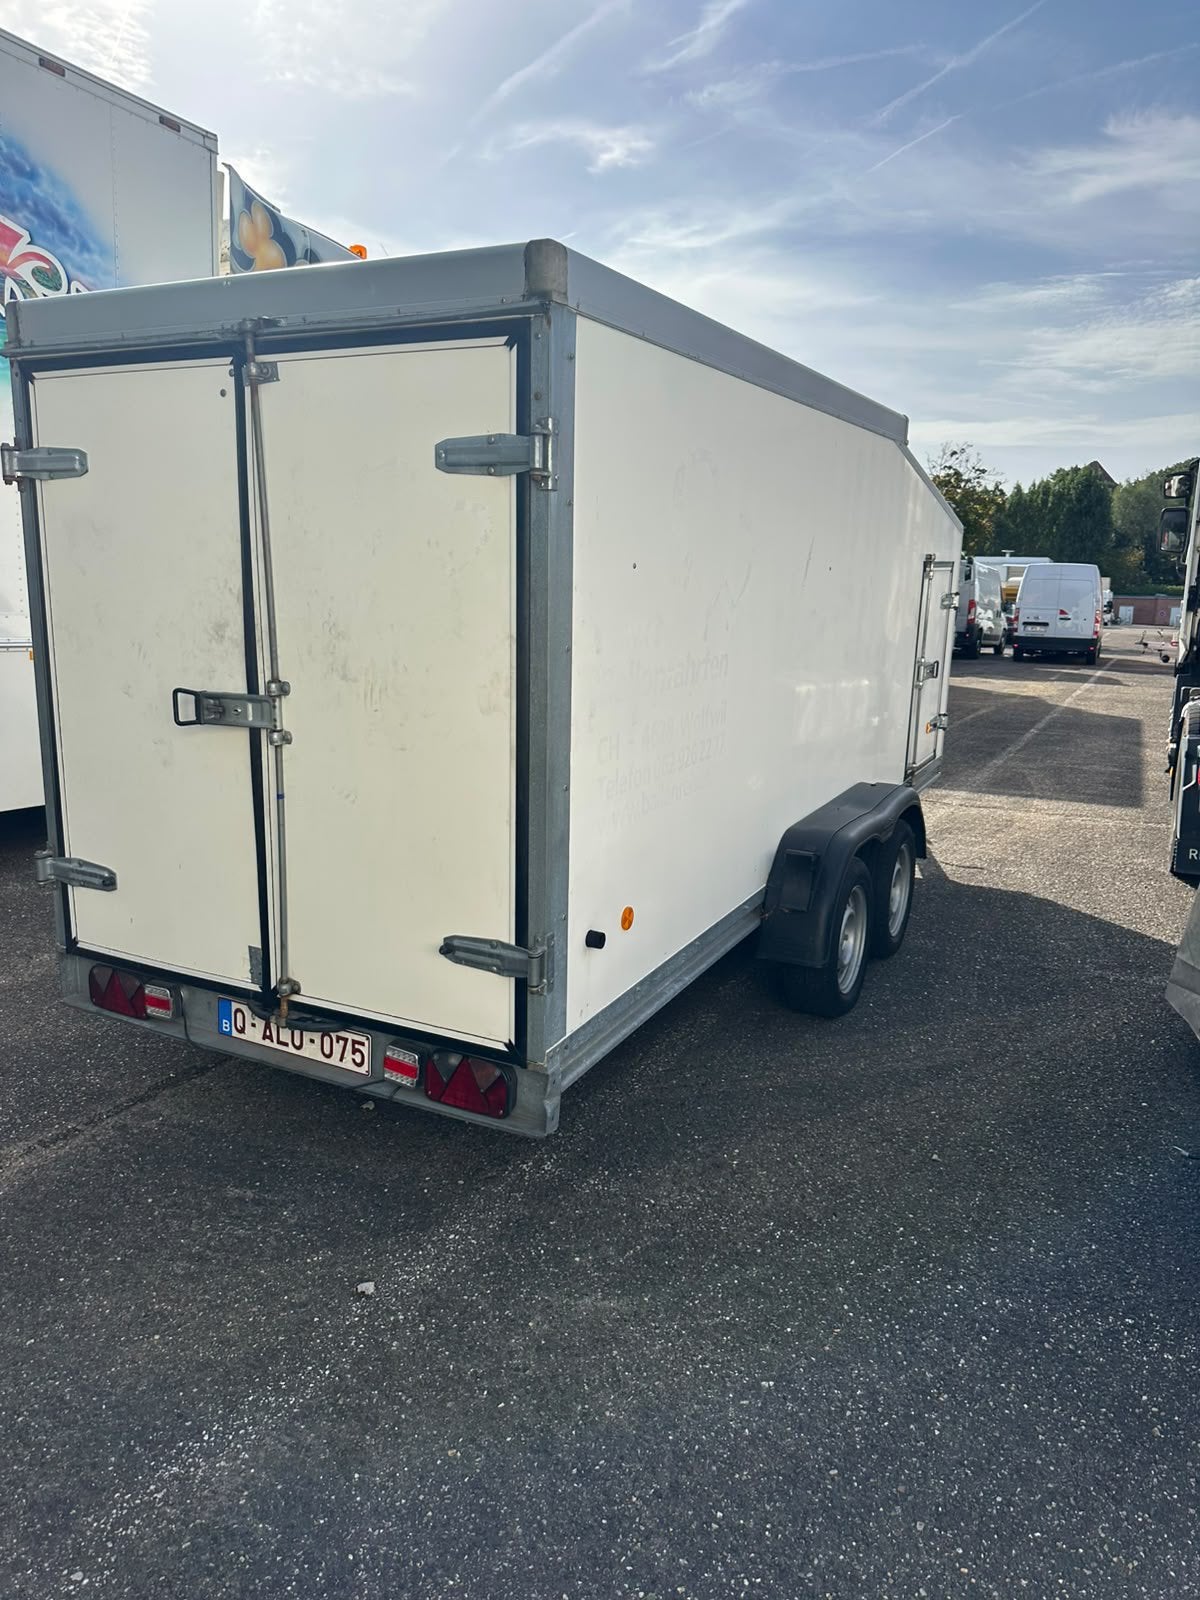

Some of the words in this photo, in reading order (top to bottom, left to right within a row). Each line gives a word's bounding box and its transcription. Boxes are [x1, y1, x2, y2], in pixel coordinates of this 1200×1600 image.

[595, 758, 650, 802] Telefon
[1189, 848, 1200, 861] R
[222, 1018, 231, 1032] B
[233, 1007, 366, 1067] Q-ALU-075
